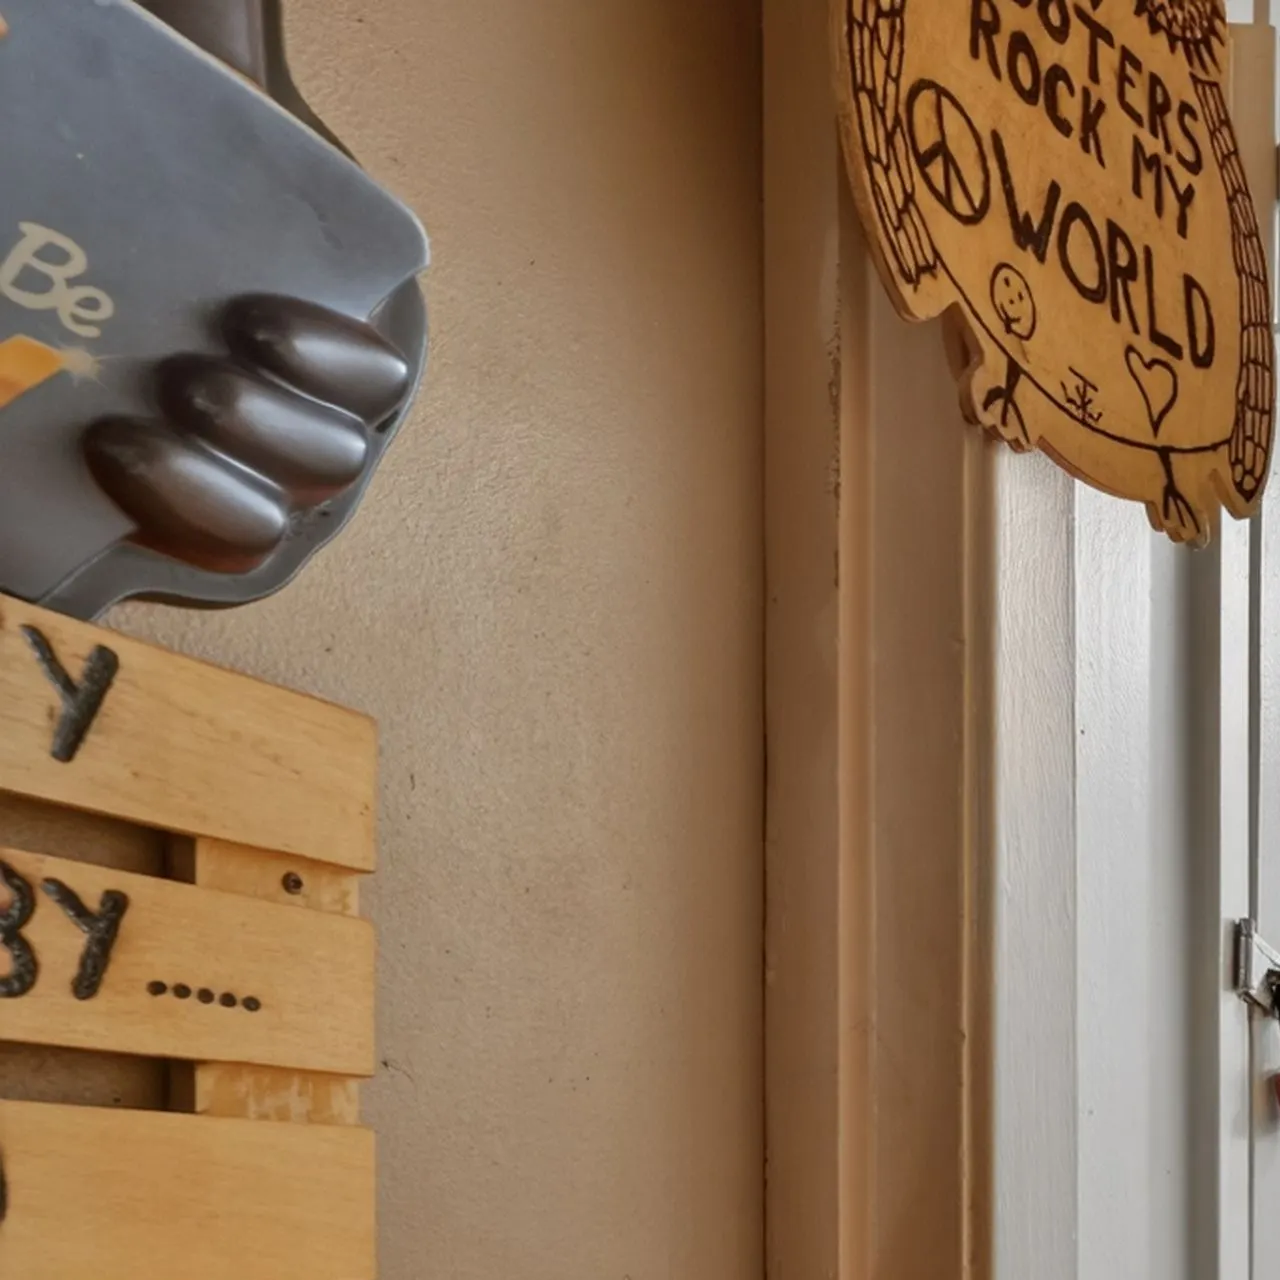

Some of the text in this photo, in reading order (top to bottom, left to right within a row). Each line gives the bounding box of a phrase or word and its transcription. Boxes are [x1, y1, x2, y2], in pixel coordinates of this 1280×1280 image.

[970, 0, 1106, 170] ROCK
[1012, 0, 1203, 176] OTERS
[991, 128, 1216, 369] WORLD
[1132, 133, 1195, 239] MY
[0, 221, 115, 339] Be
